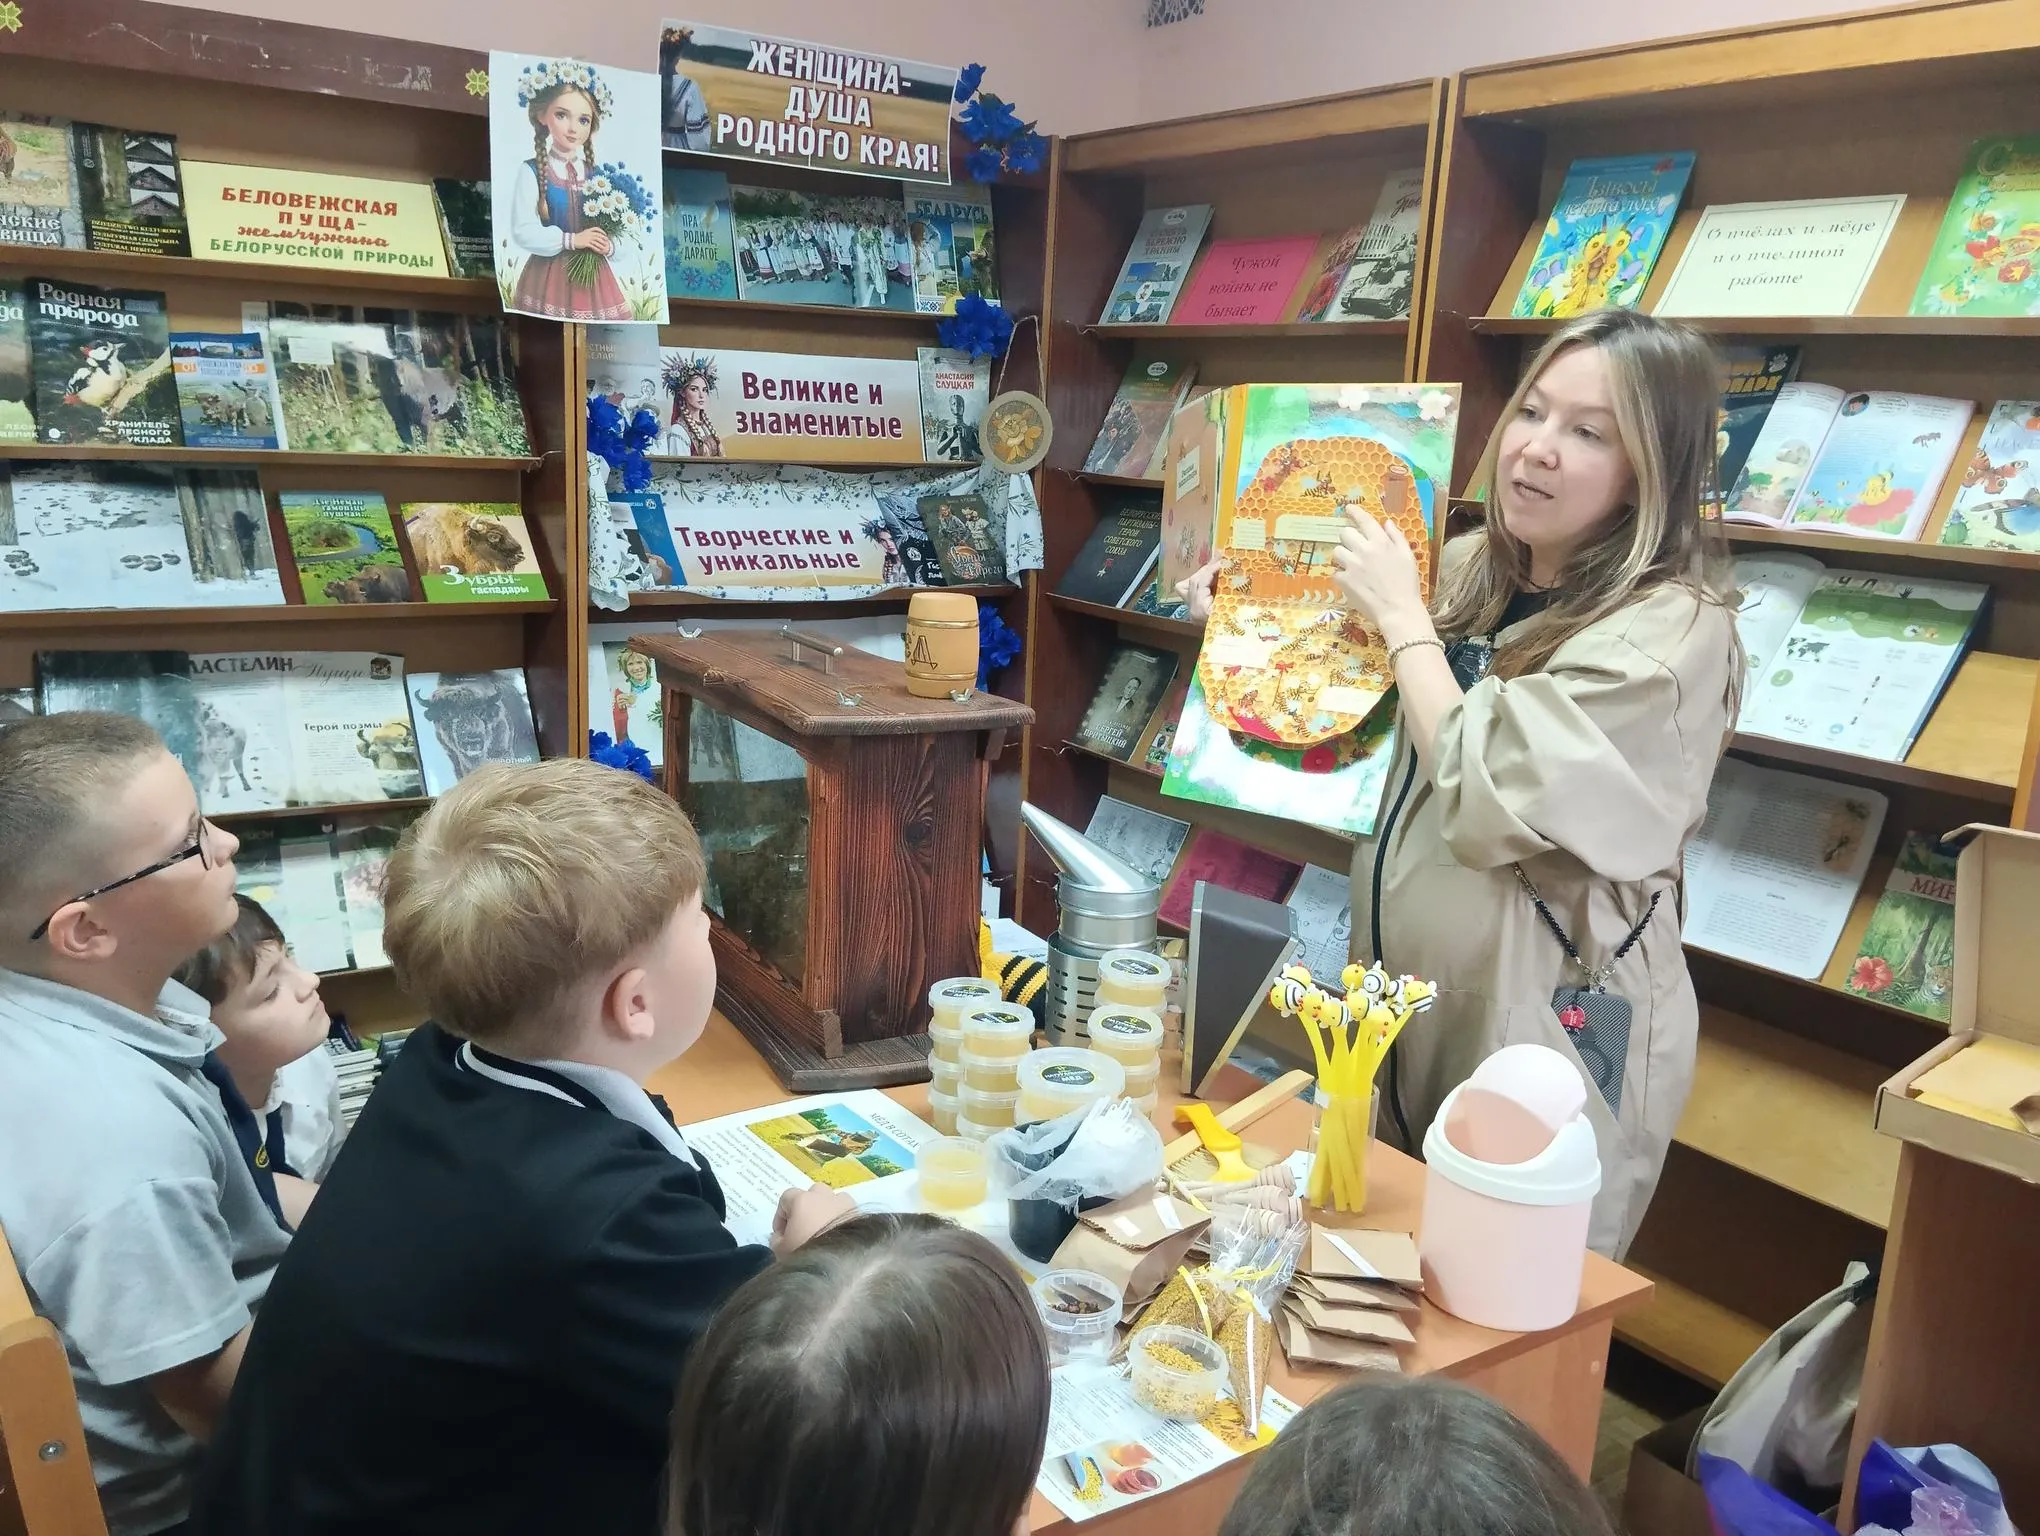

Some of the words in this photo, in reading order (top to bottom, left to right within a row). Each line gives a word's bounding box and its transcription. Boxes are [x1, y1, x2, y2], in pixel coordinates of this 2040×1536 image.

[746, 41, 912, 95] ЖЕНЩИНА-
[784, 86, 872, 128] ДУША
[716, 114, 849, 162] РОДНОГО
[860, 133, 939, 173] КРАЯ!
[222, 187, 398, 216] БЕЛОВЕЖСКАЯ
[279, 212, 366, 231] ПУЩА-
[682, 214, 698, 227] ПРА
[915, 200, 989, 224] БЕЛАРУСЬ
[237, 225, 389, 247] жемчужина
[1707, 227, 1721, 239] О
[1727, 225, 1796, 240] пчёлах
[1803, 225, 1816, 235] и
[1821, 220, 1876, 236] мёде
[210, 238, 343, 260] БЕЛОРУССКОЙ
[353, 250, 434, 268] ПРИРОДЫ
[685, 246, 719, 261] ДАРАГОЕ
[1713, 254, 1724, 264] и
[1747, 244, 1845, 262] пчелиной
[1232, 254, 1281, 274] Чужой
[1209, 280, 1257, 295] войны
[1258, 281, 1278, 292] не
[1727, 272, 1803, 290] работе
[38, 283, 121, 310] Родная
[40, 302, 139, 328] прырода
[1205, 303, 1258, 317] бывает
[936, 373, 975, 381] АНАСТАСИЯ
[936, 381, 975, 390] СЛУЦКАЯ
[742, 372, 858, 404] Великие
[869, 384, 883, 405] и
[105, 420, 170, 429] ХРАНИТЕЛЬ
[118, 428, 171, 436] ЛЕСНОГО
[735, 409, 903, 439] знаменитые
[127, 435, 172, 443] УКЛАДА
[674, 525, 831, 550] Творческие
[839, 527, 854, 546] и
[1104, 535, 1143, 547] СОВЕТСКОГО
[1105, 546, 1128, 556] СОЮЗА
[697, 547, 861, 575] уникальные
[471, 586, 530, 595] гаспадары
[304, 723, 339, 732] Герой
[343, 722, 383, 731] поэмы
[1096, 724, 1123, 737] СЕРГЕЙ
